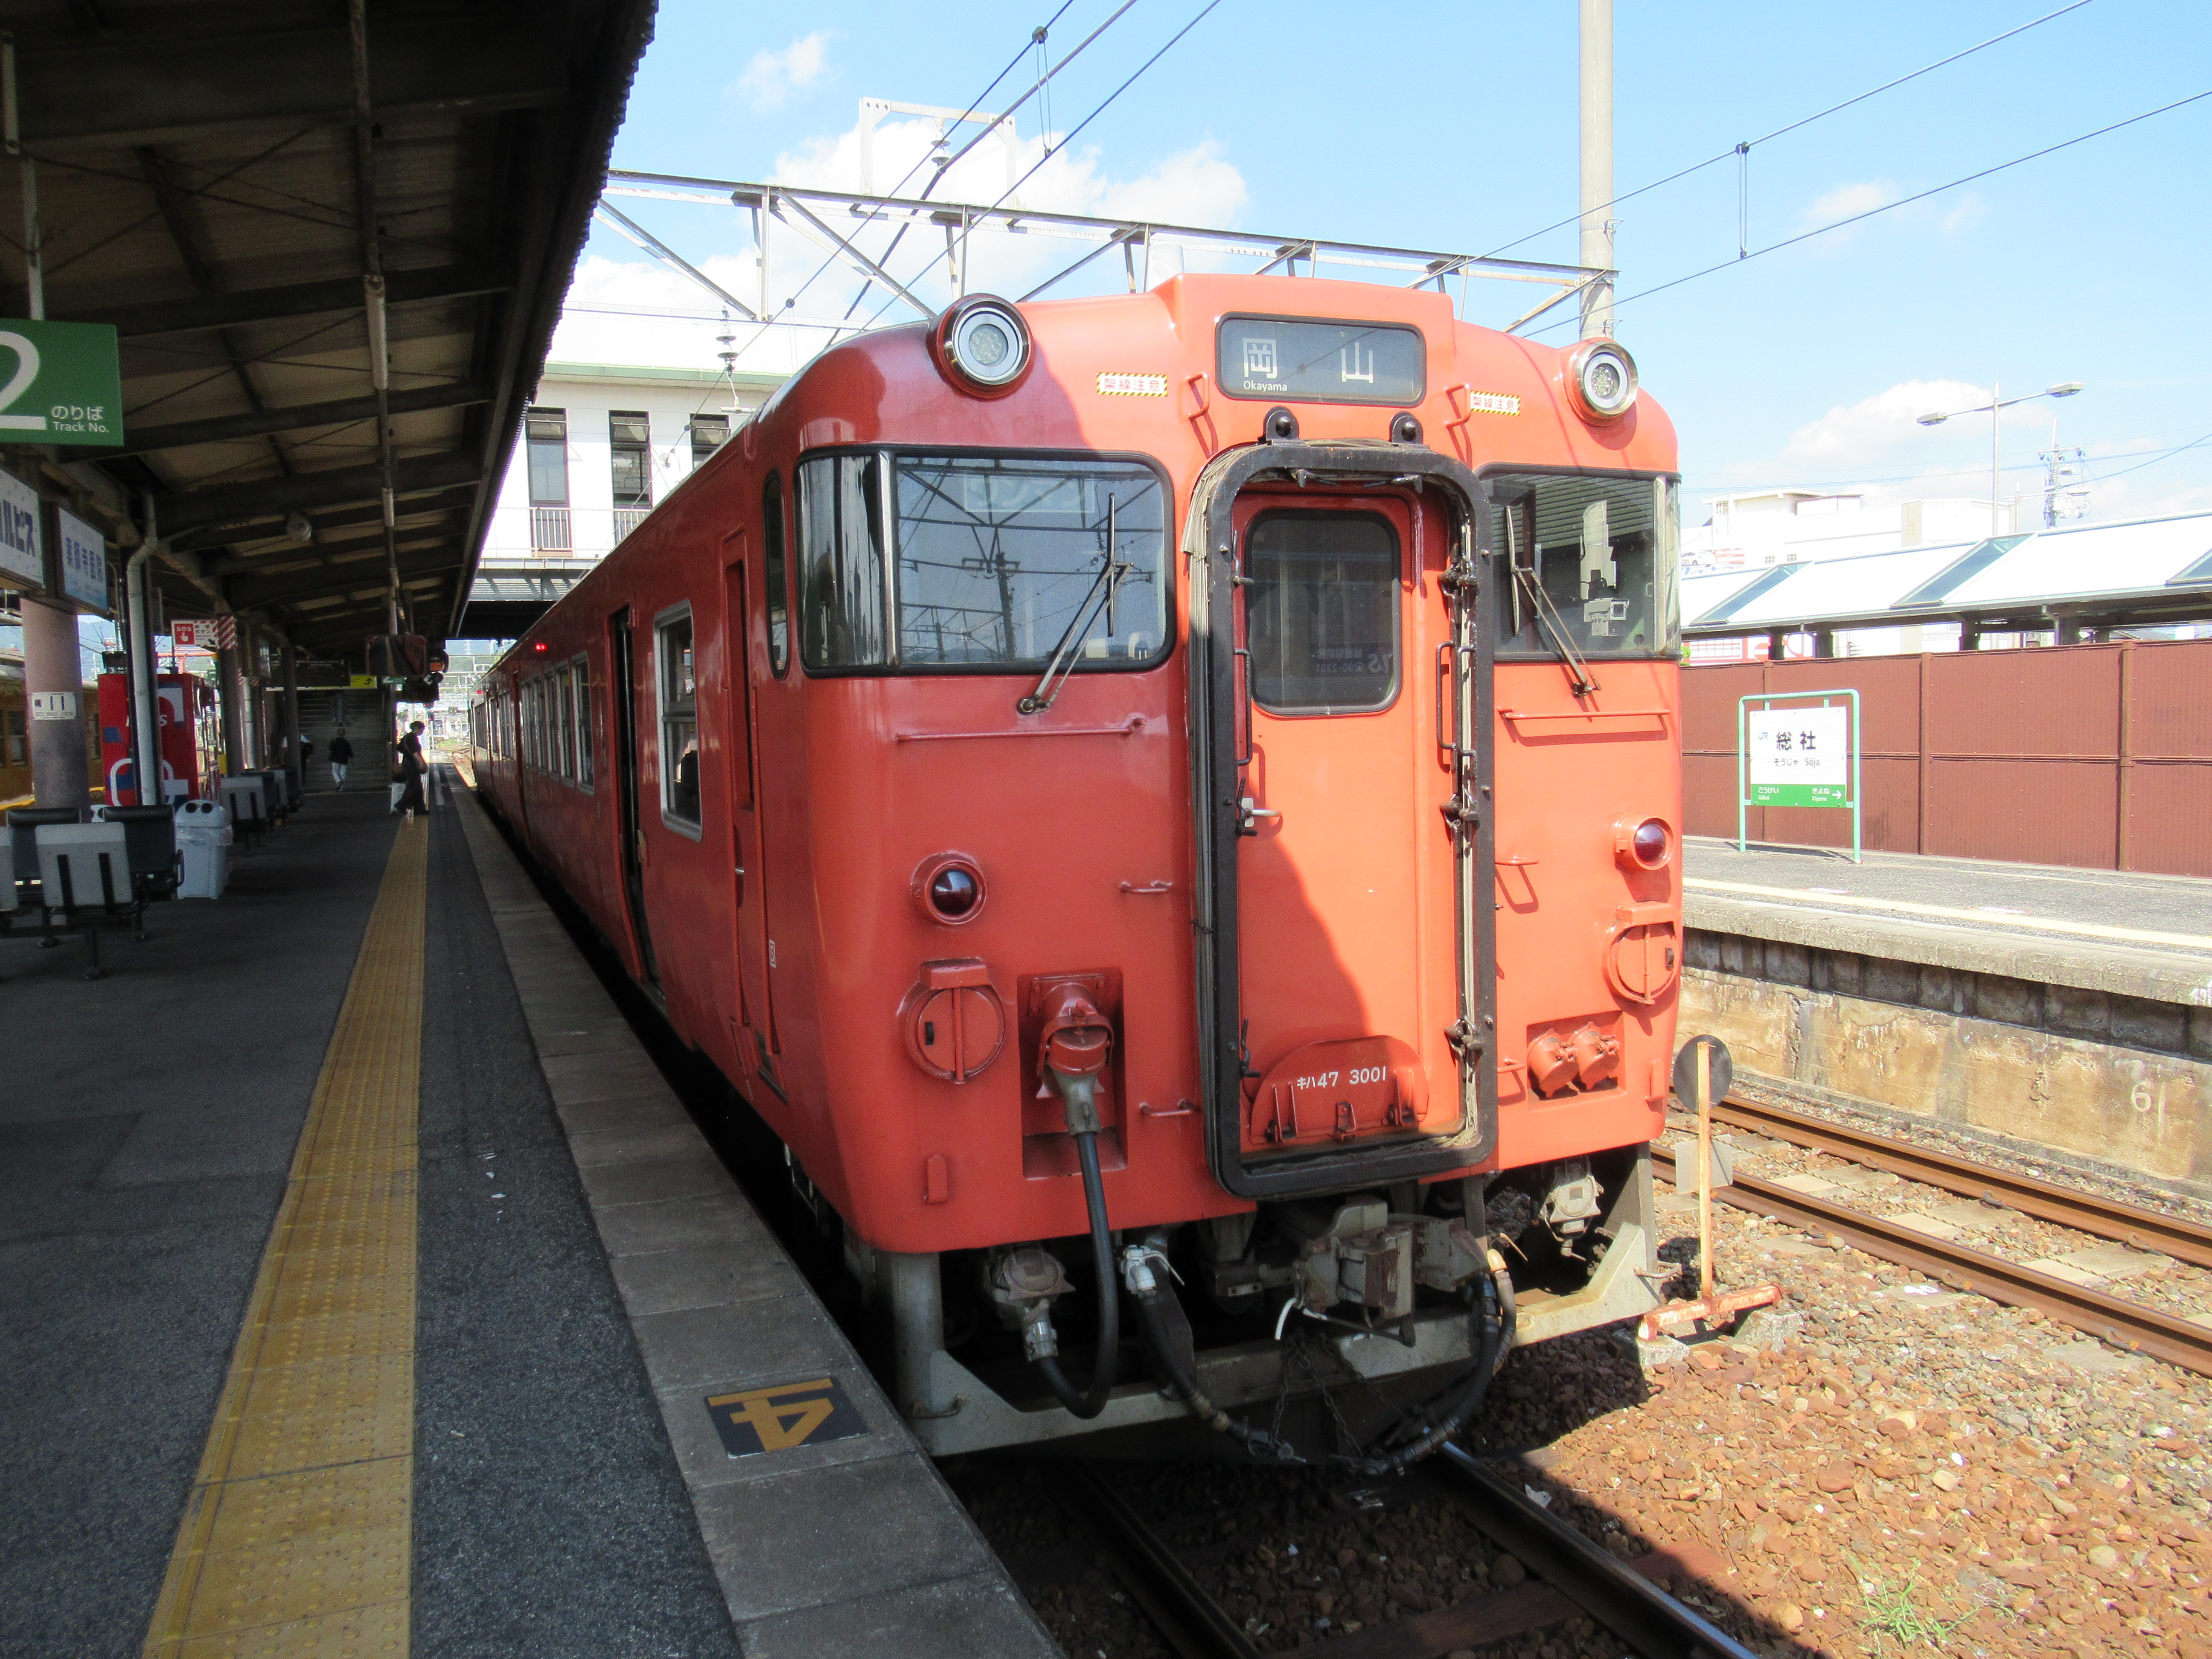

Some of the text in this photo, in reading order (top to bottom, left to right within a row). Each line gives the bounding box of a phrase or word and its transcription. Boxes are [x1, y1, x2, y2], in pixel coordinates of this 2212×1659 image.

[1242, 338, 1374, 384] 岡山
[0, 331, 47, 430] 2
[1103, 376, 1162, 392] 架線注意
[1243, 380, 1288, 393] Okayama
[1472, 396, 1515, 411] 架線注意
[52, 405, 103, 420] のりば
[52, 421, 110, 433] Track No.
[1758, 731, 1769, 740] JR
[1776, 731, 1816, 751] 総社
[1774, 757, 1820, 768] そうじゃ Sōja
[1296, 1065, 1387, 1090] キハ47 3001
